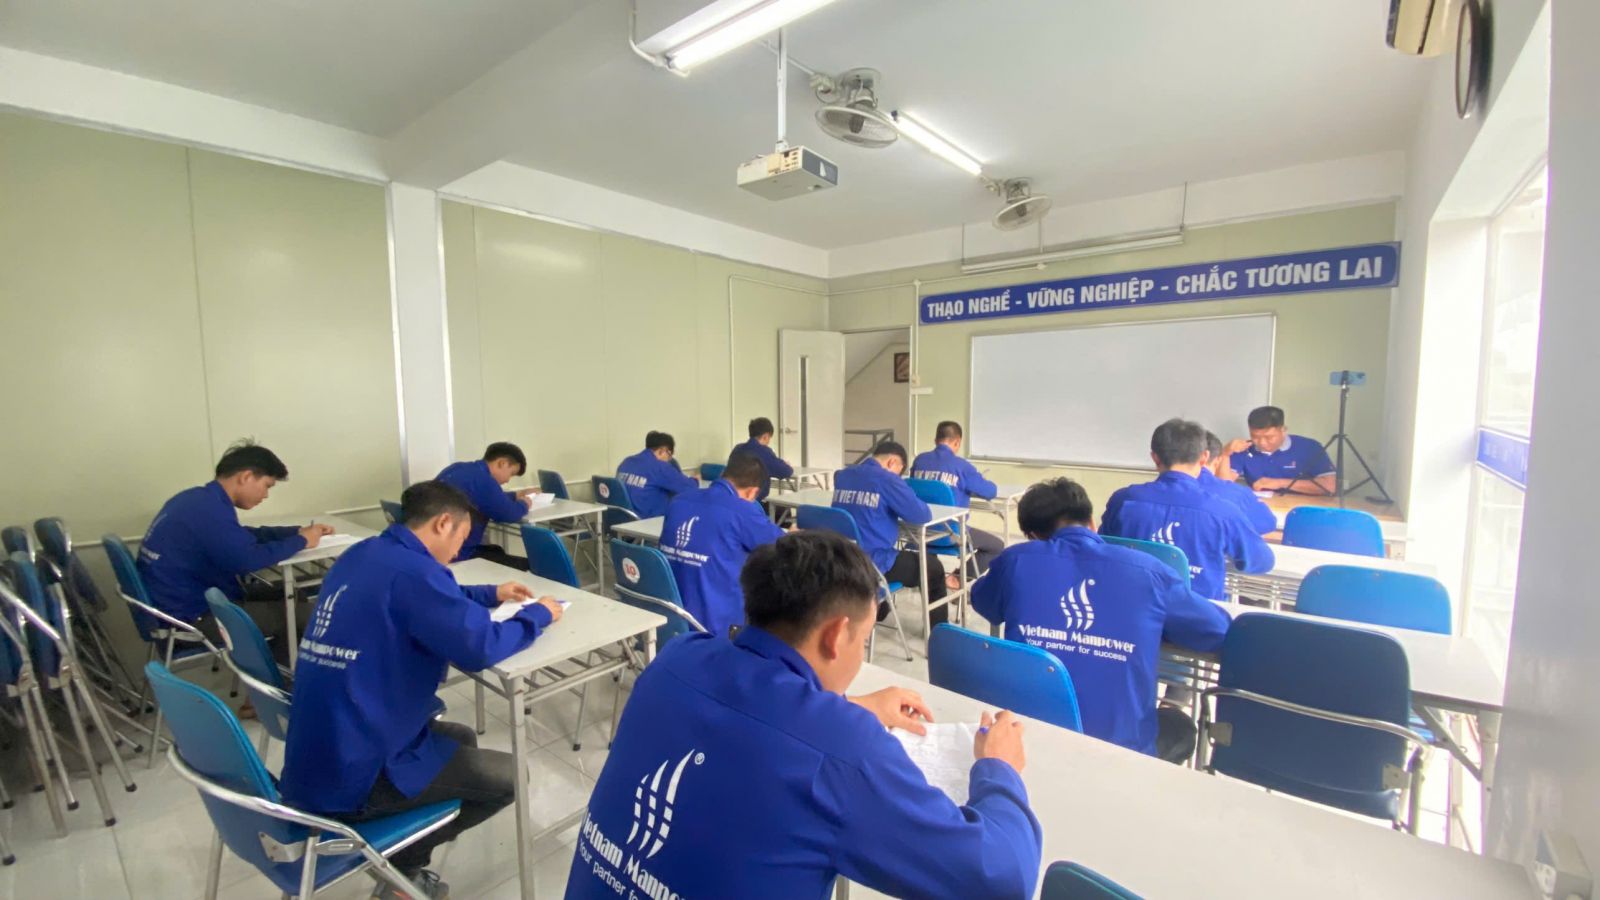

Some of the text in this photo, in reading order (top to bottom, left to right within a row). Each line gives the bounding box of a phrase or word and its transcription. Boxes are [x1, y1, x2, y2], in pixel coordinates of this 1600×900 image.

[927, 300, 964, 319] THẠO
[968, 289, 1011, 314] NGHỀ
[1027, 287, 1075, 309] VỮNG
[1080, 277, 1154, 303] NGHIỆP
[1176, 265, 1238, 295] CHẮC
[1245, 261, 1330, 289] TƯƠNG
[1339, 256, 1383, 281] LAI
[856, 490, 880, 509] NAM
[1018, 624, 1136, 653] Vietnam Manpower
[1046, 641, 1076, 652] partner
[1078, 645, 1090, 654] for
[1094, 649, 1127, 662] success
[593, 861, 626, 895] partner
